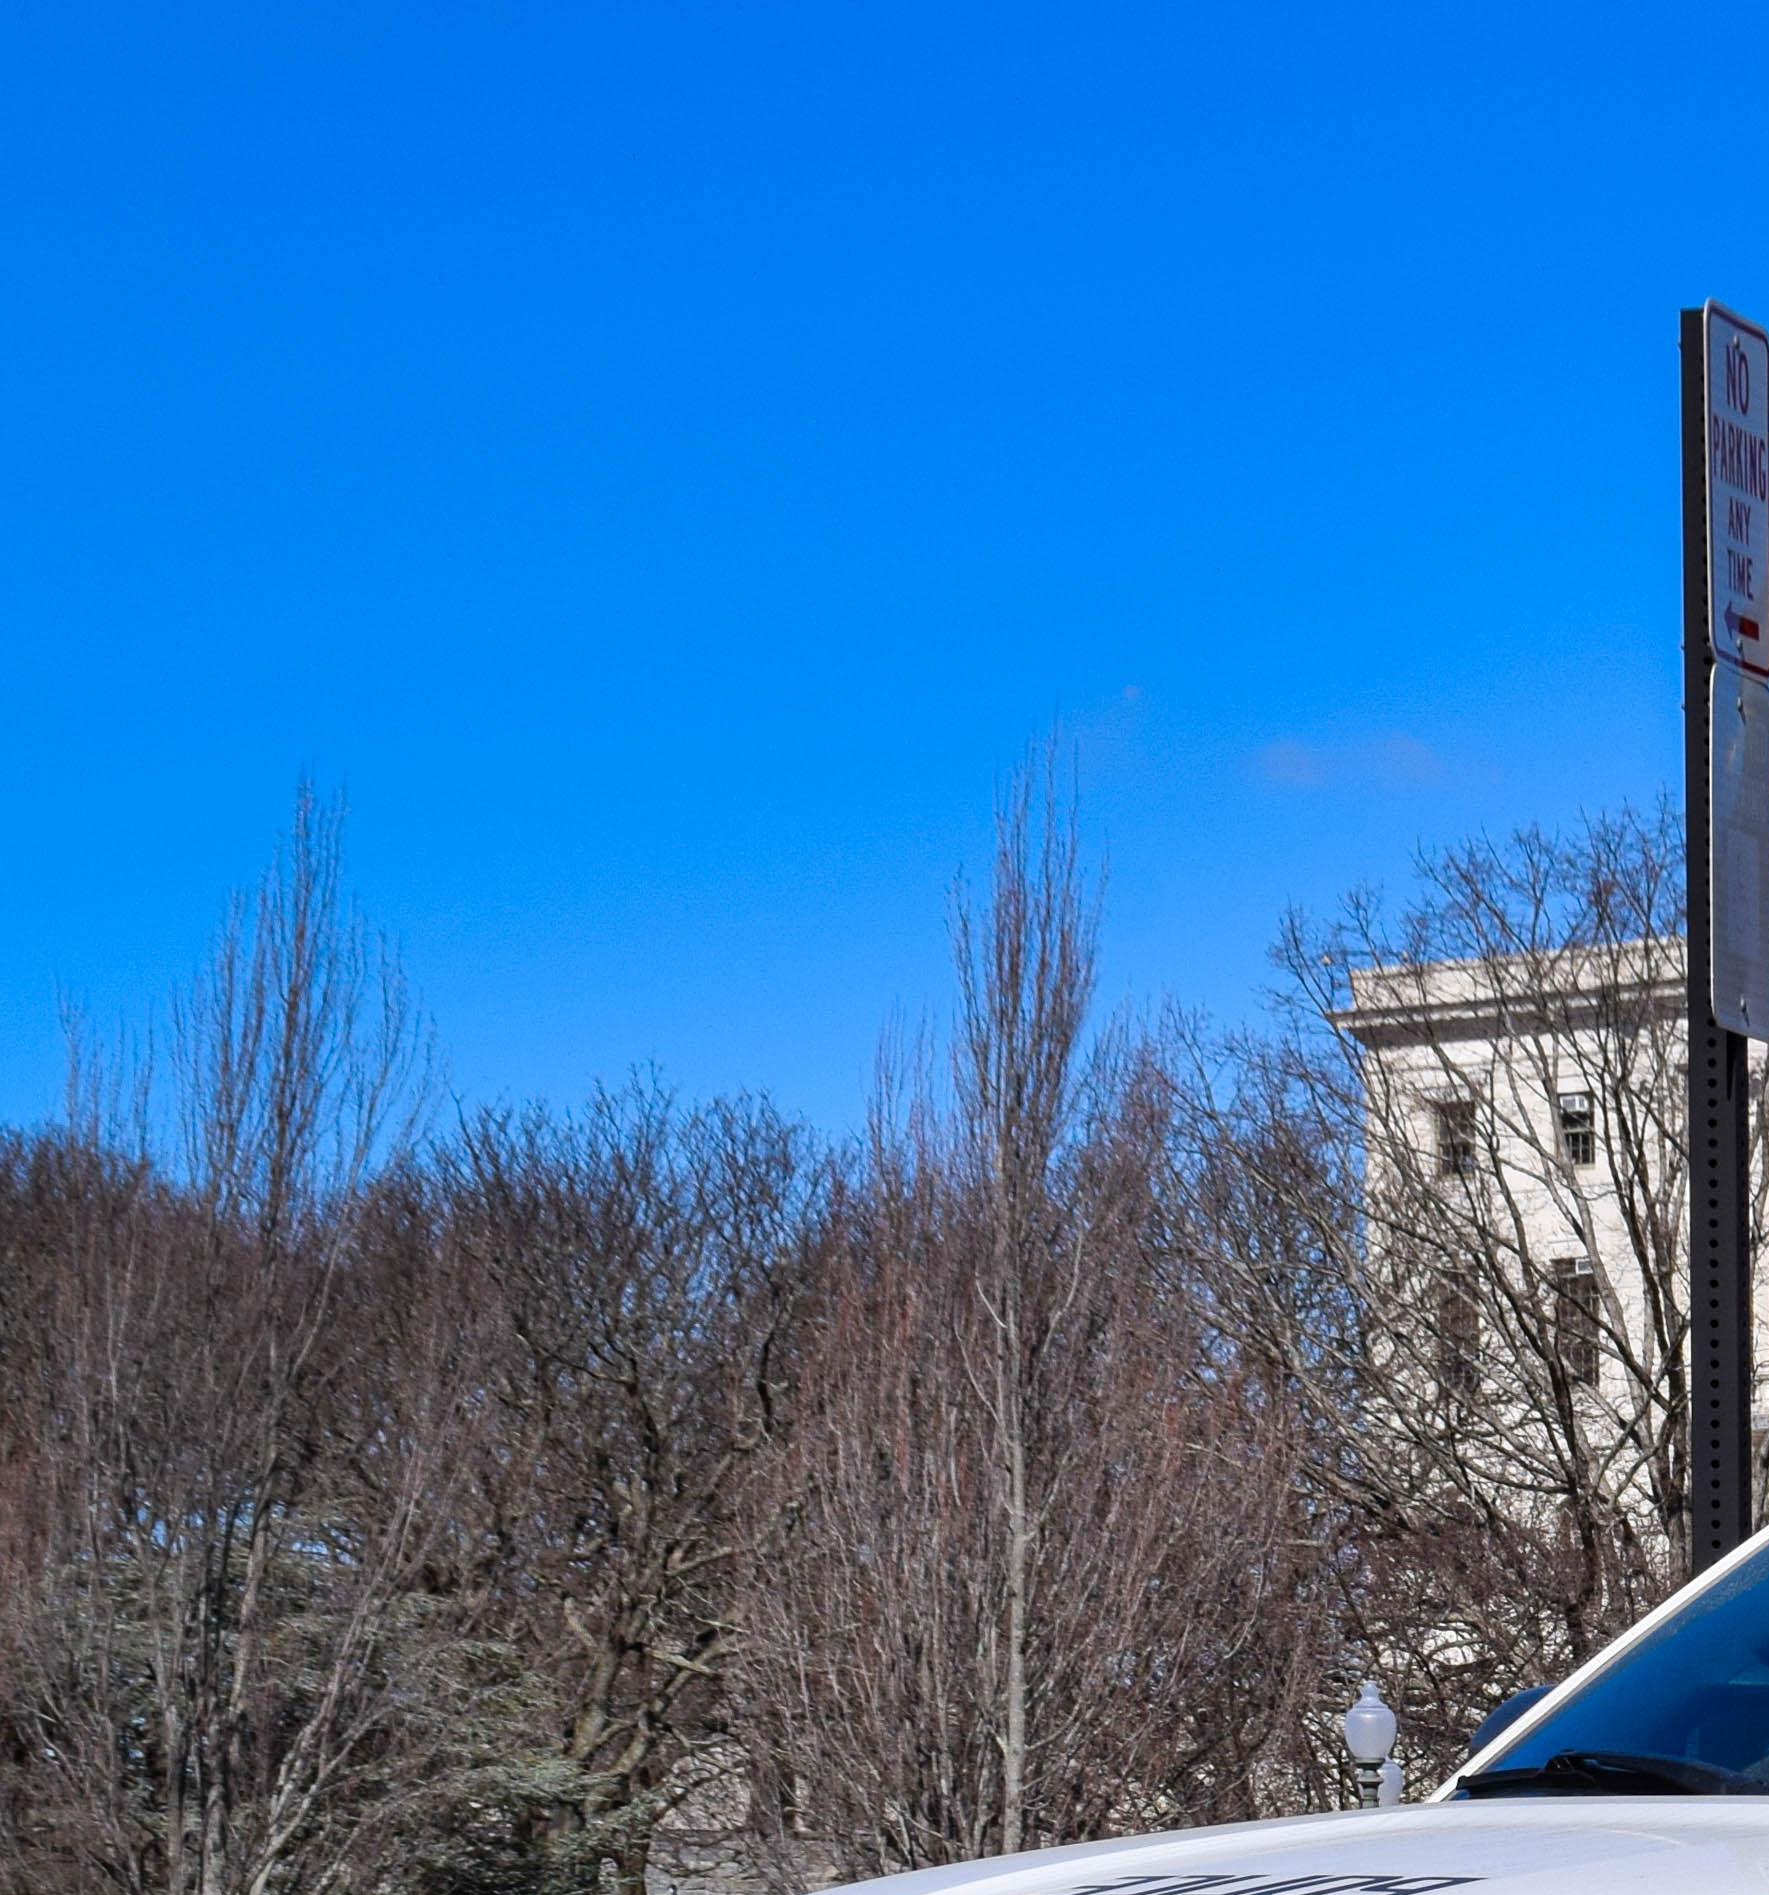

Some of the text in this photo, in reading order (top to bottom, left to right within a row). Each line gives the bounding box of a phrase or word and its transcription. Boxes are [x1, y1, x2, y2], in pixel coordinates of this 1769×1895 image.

[1726, 343, 1749, 415] NO
[1712, 413, 1767, 502] PARKING
[1728, 496, 1751, 545] ANY
[1727, 548, 1754, 600] TIME
